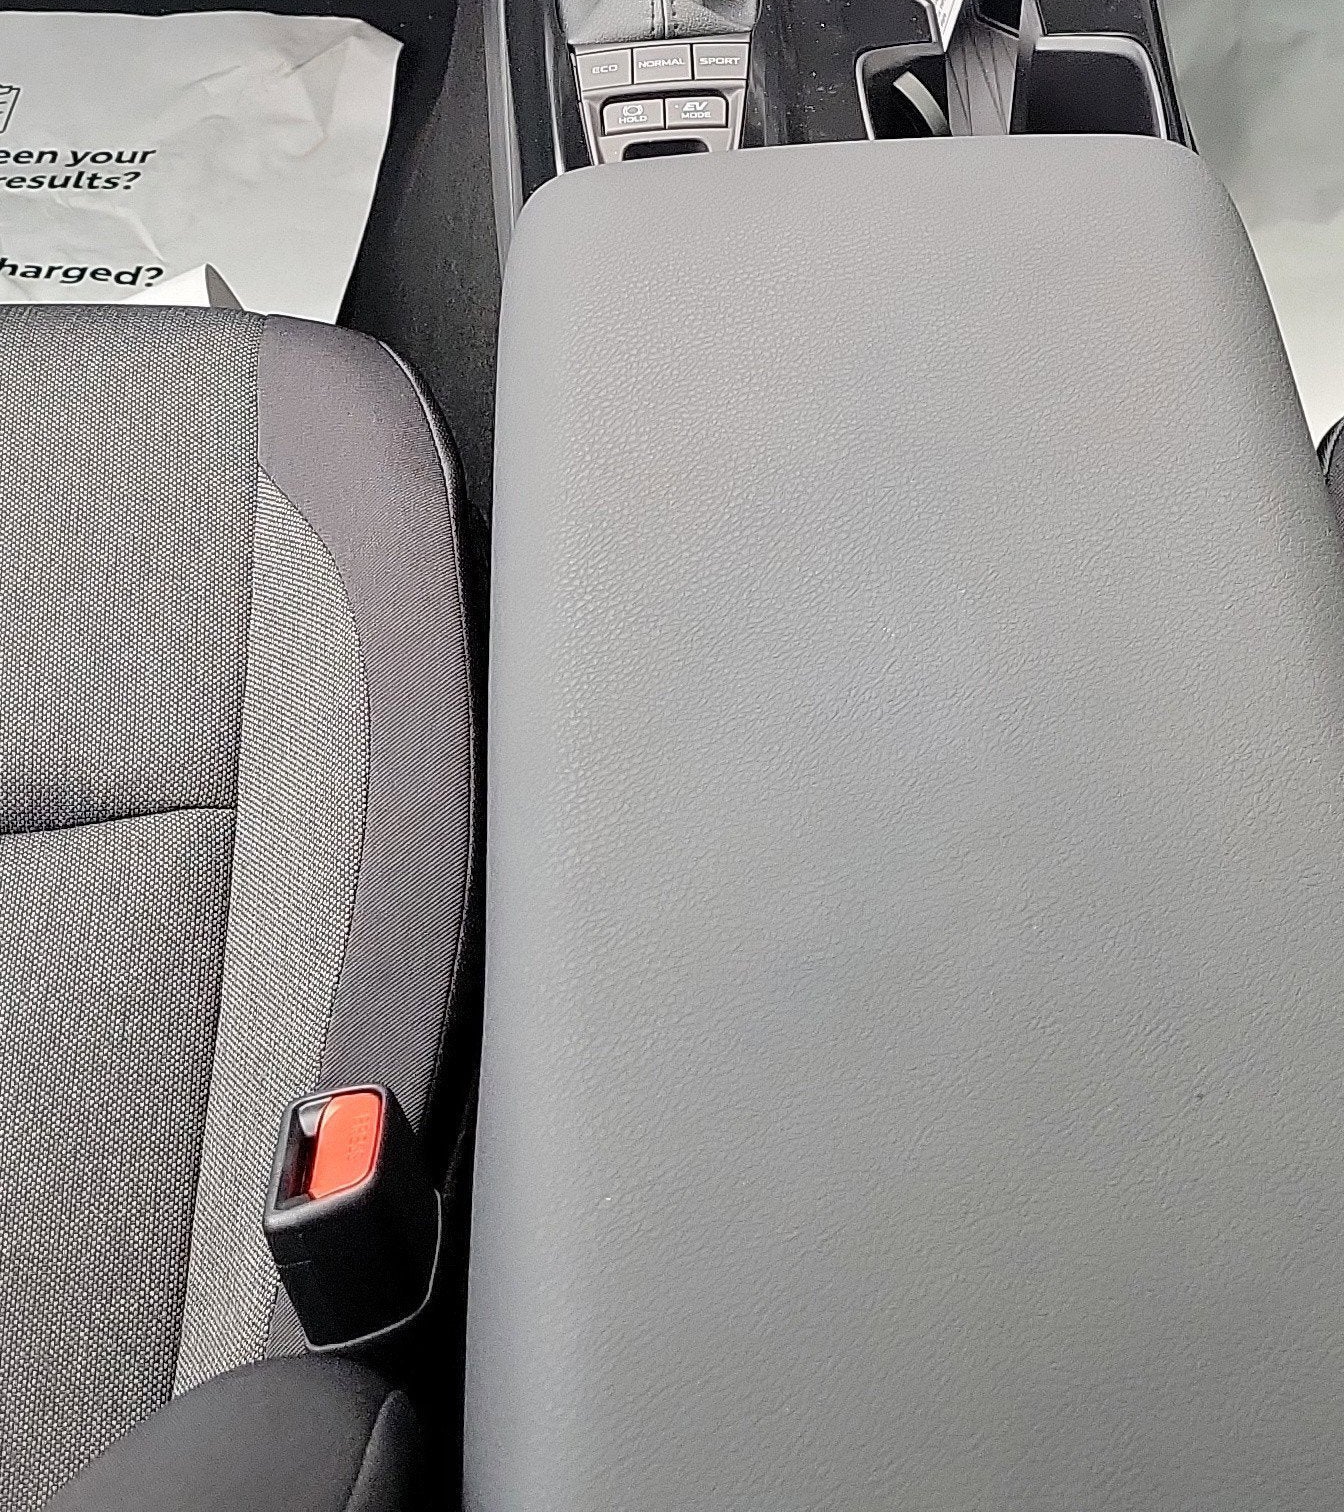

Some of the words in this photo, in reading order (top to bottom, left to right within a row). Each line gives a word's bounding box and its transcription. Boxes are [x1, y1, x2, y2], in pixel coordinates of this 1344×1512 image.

[638, 57, 686, 69] NORMAL
[699, 56, 741, 65] SPORT
[592, 64, 618, 74] ECO
[682, 101, 708, 111] EV
[618, 114, 648, 124] HOLD
[681, 111, 712, 119] MODE
[65, 147, 156, 168] your
